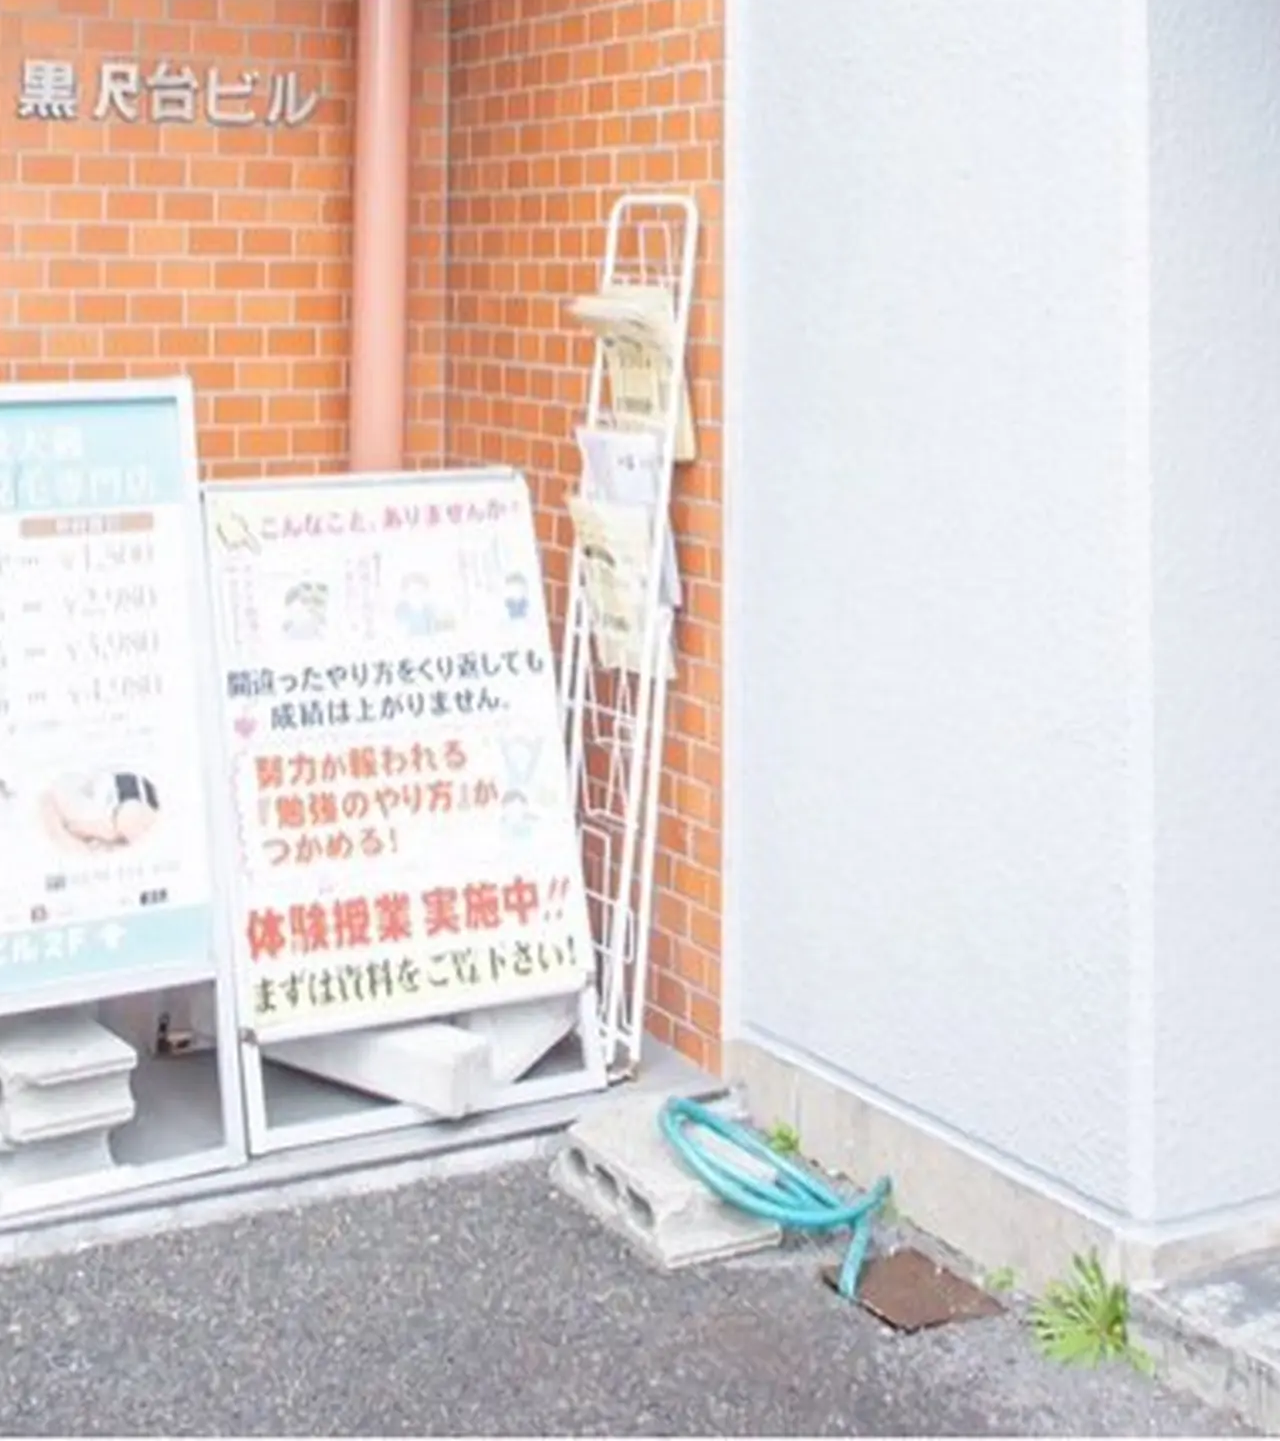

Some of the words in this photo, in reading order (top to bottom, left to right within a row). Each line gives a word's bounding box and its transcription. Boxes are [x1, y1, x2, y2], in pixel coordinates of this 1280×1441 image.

[226, 648, 546, 699] 間違ったやり方をくり返しても
[253, 739, 469, 789] 努力が報われる
